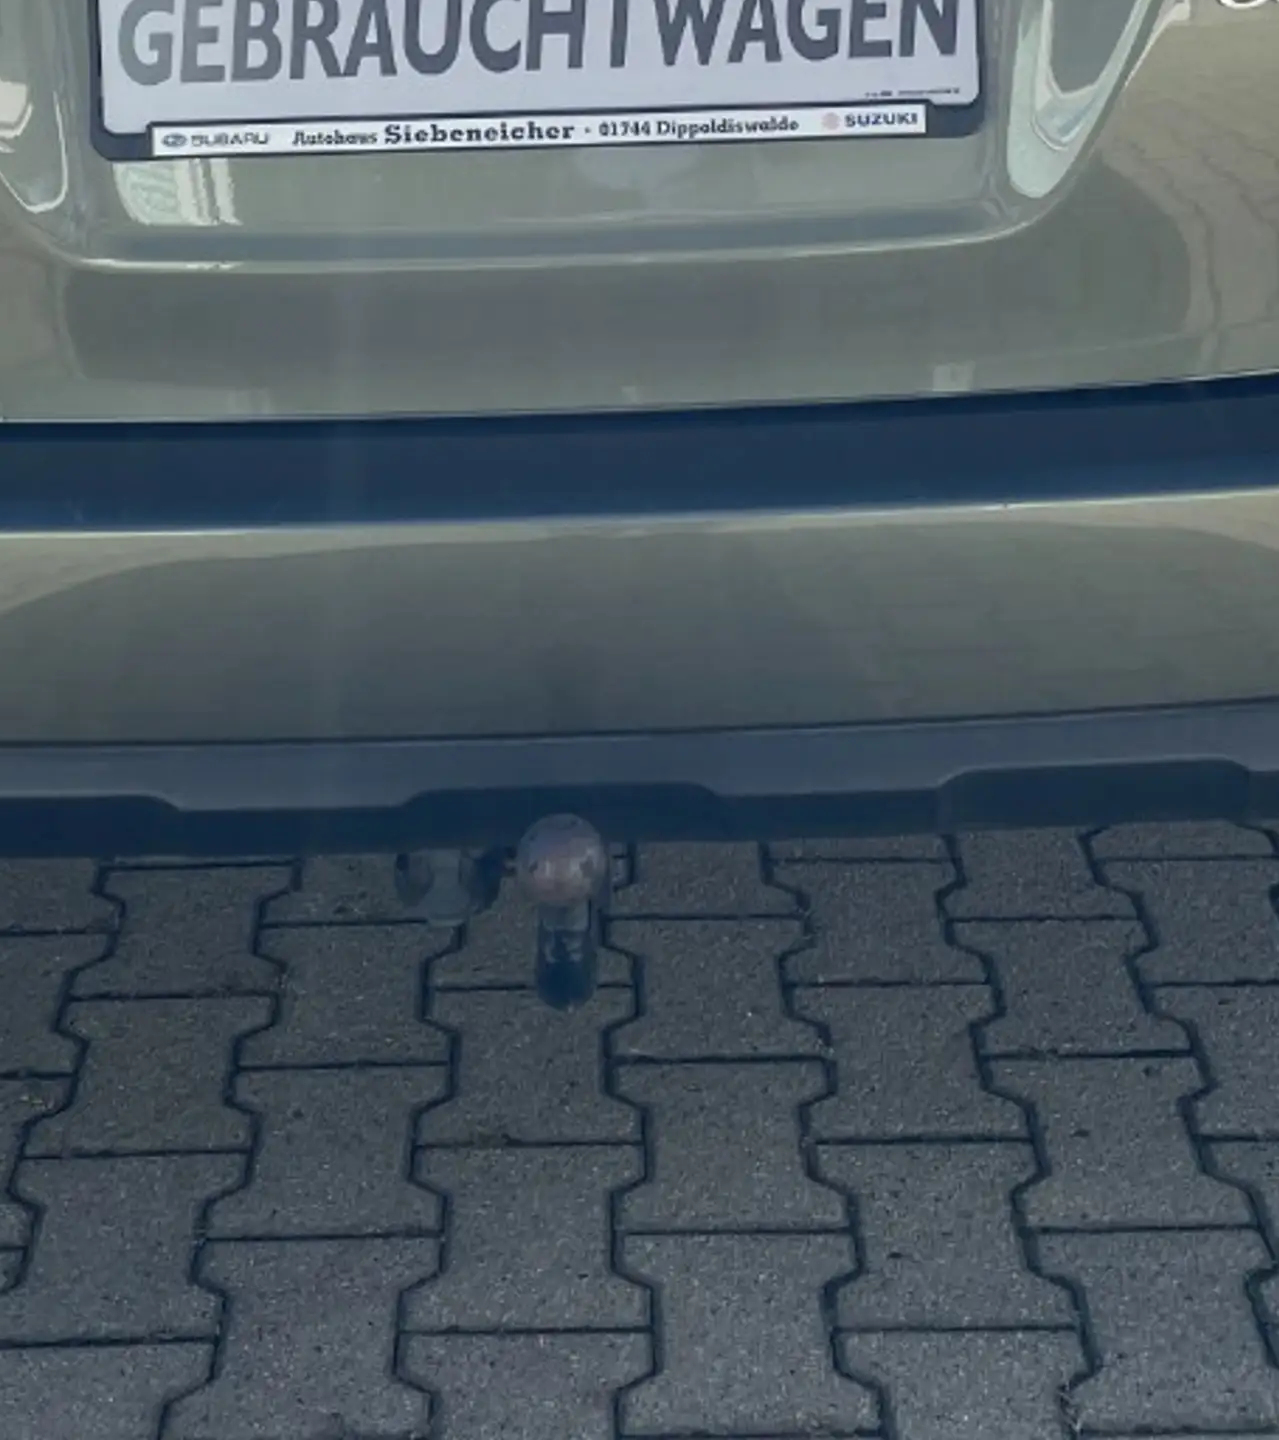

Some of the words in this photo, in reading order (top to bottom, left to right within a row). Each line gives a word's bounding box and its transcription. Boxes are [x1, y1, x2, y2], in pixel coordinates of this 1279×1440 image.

[190, 131, 270, 147] SUBARU
[291, 128, 378, 147] Autohaus
[383, 120, 576, 144] Siebeneicher
[598, 120, 651, 137] 01744
[656, 115, 800, 139] Dippoldiswalde
[844, 111, 919, 128] SUZUKI
